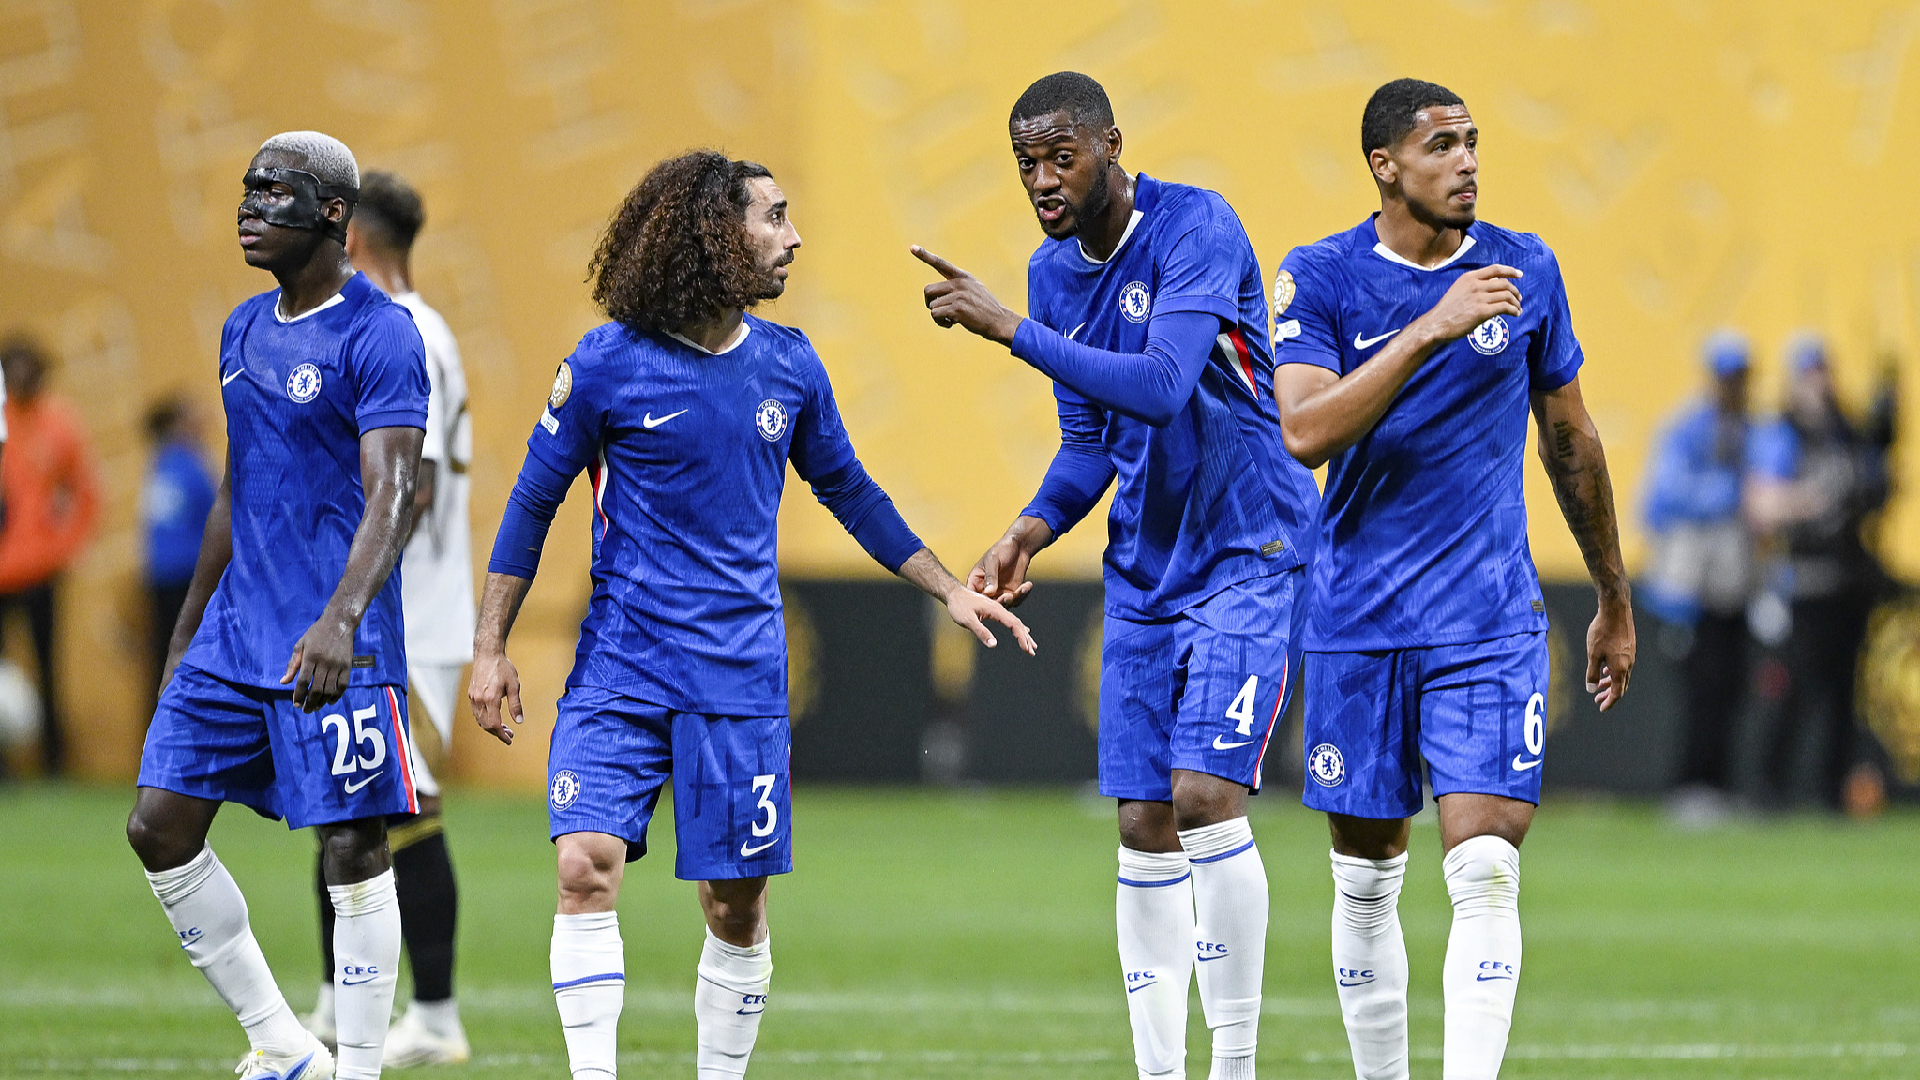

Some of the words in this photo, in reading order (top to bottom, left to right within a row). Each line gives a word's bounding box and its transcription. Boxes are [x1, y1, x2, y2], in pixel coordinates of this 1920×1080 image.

[1225, 675, 1259, 736] 4
[1523, 692, 1545, 756] 6
[320, 702, 387, 776] 25
[751, 773, 777, 837] 3
[176, 926, 202, 938] FC
[1196, 940, 1228, 952] CFC
[343, 966, 379, 975] CFC
[1339, 967, 1374, 978] CFC
[1479, 961, 1513, 974] CFC
[1127, 970, 1155, 982] CFC
